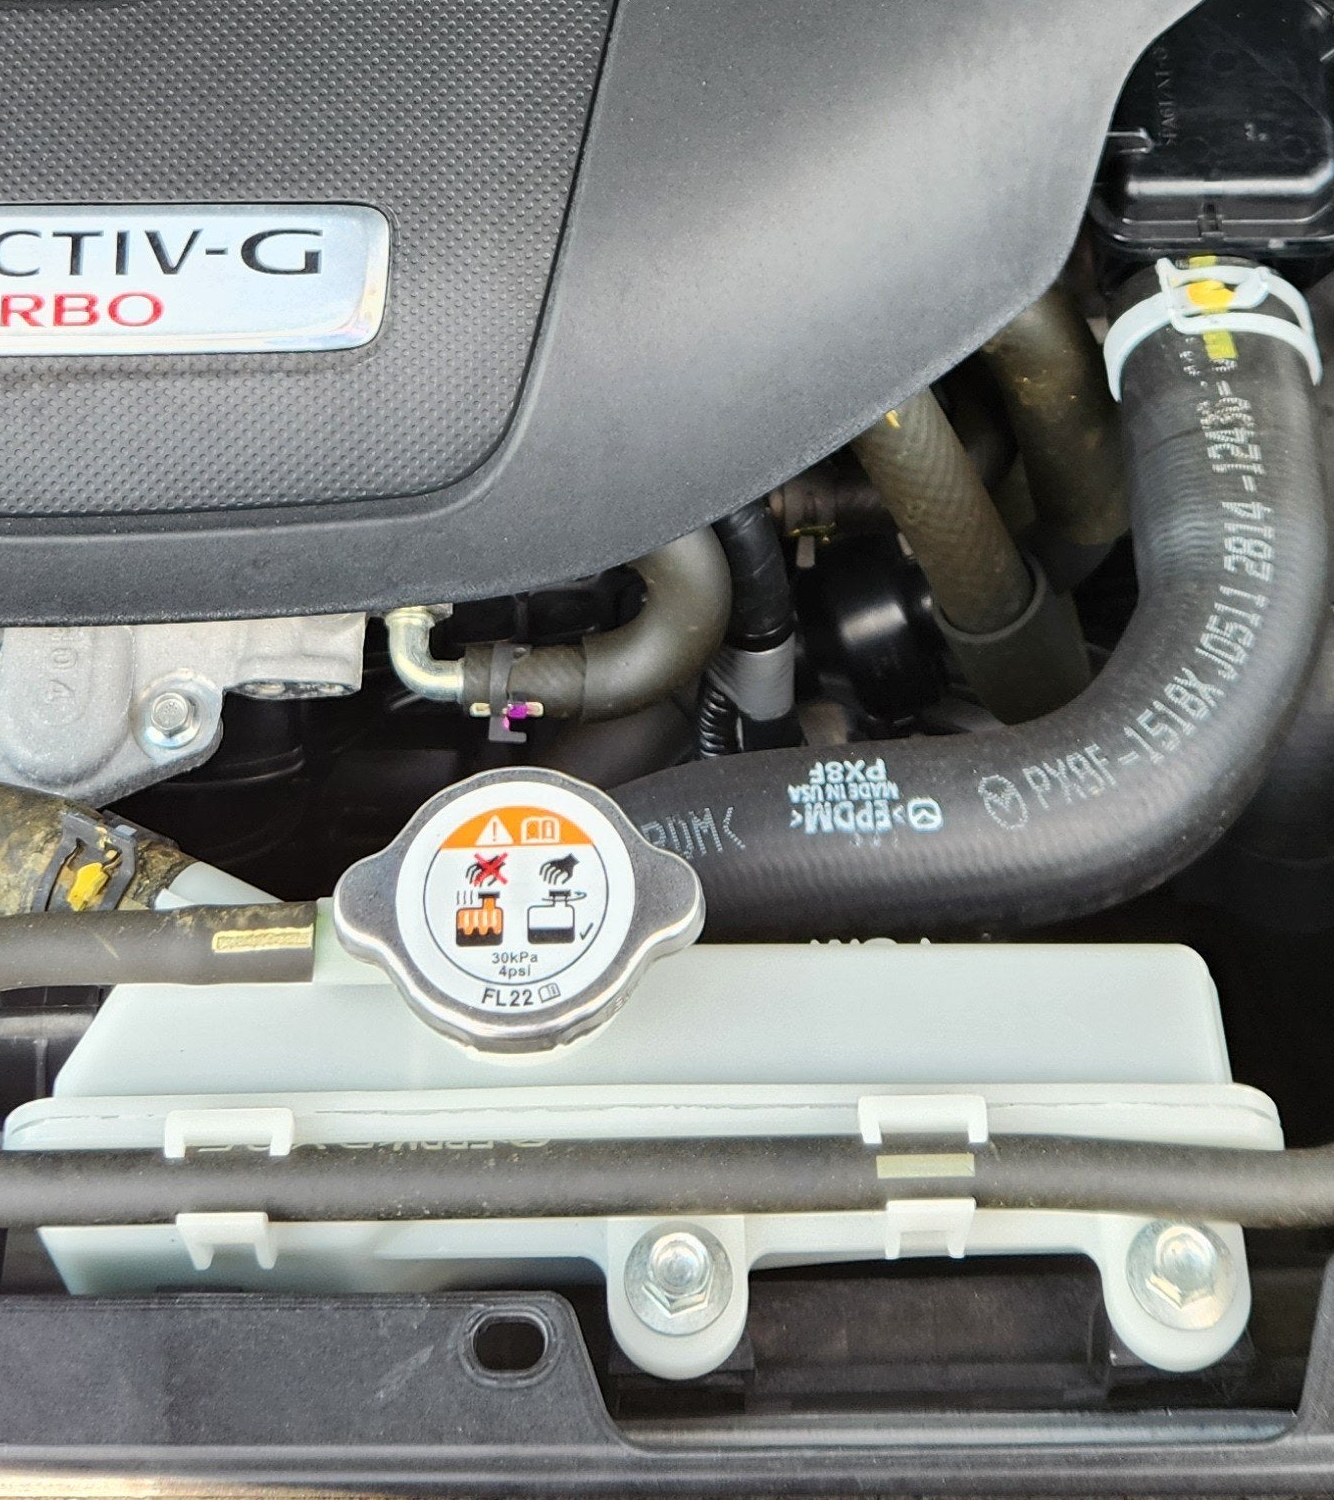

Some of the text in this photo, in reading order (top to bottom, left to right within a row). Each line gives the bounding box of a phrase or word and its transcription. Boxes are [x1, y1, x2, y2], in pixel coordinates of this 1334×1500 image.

[807, 757, 888, 786] PX8F
[787, 780, 900, 804] MADE IN USA
[491, 952, 538, 965] 30kPa
[498, 966, 531, 977] 4psi
[481, 987, 534, 1007] FL22
